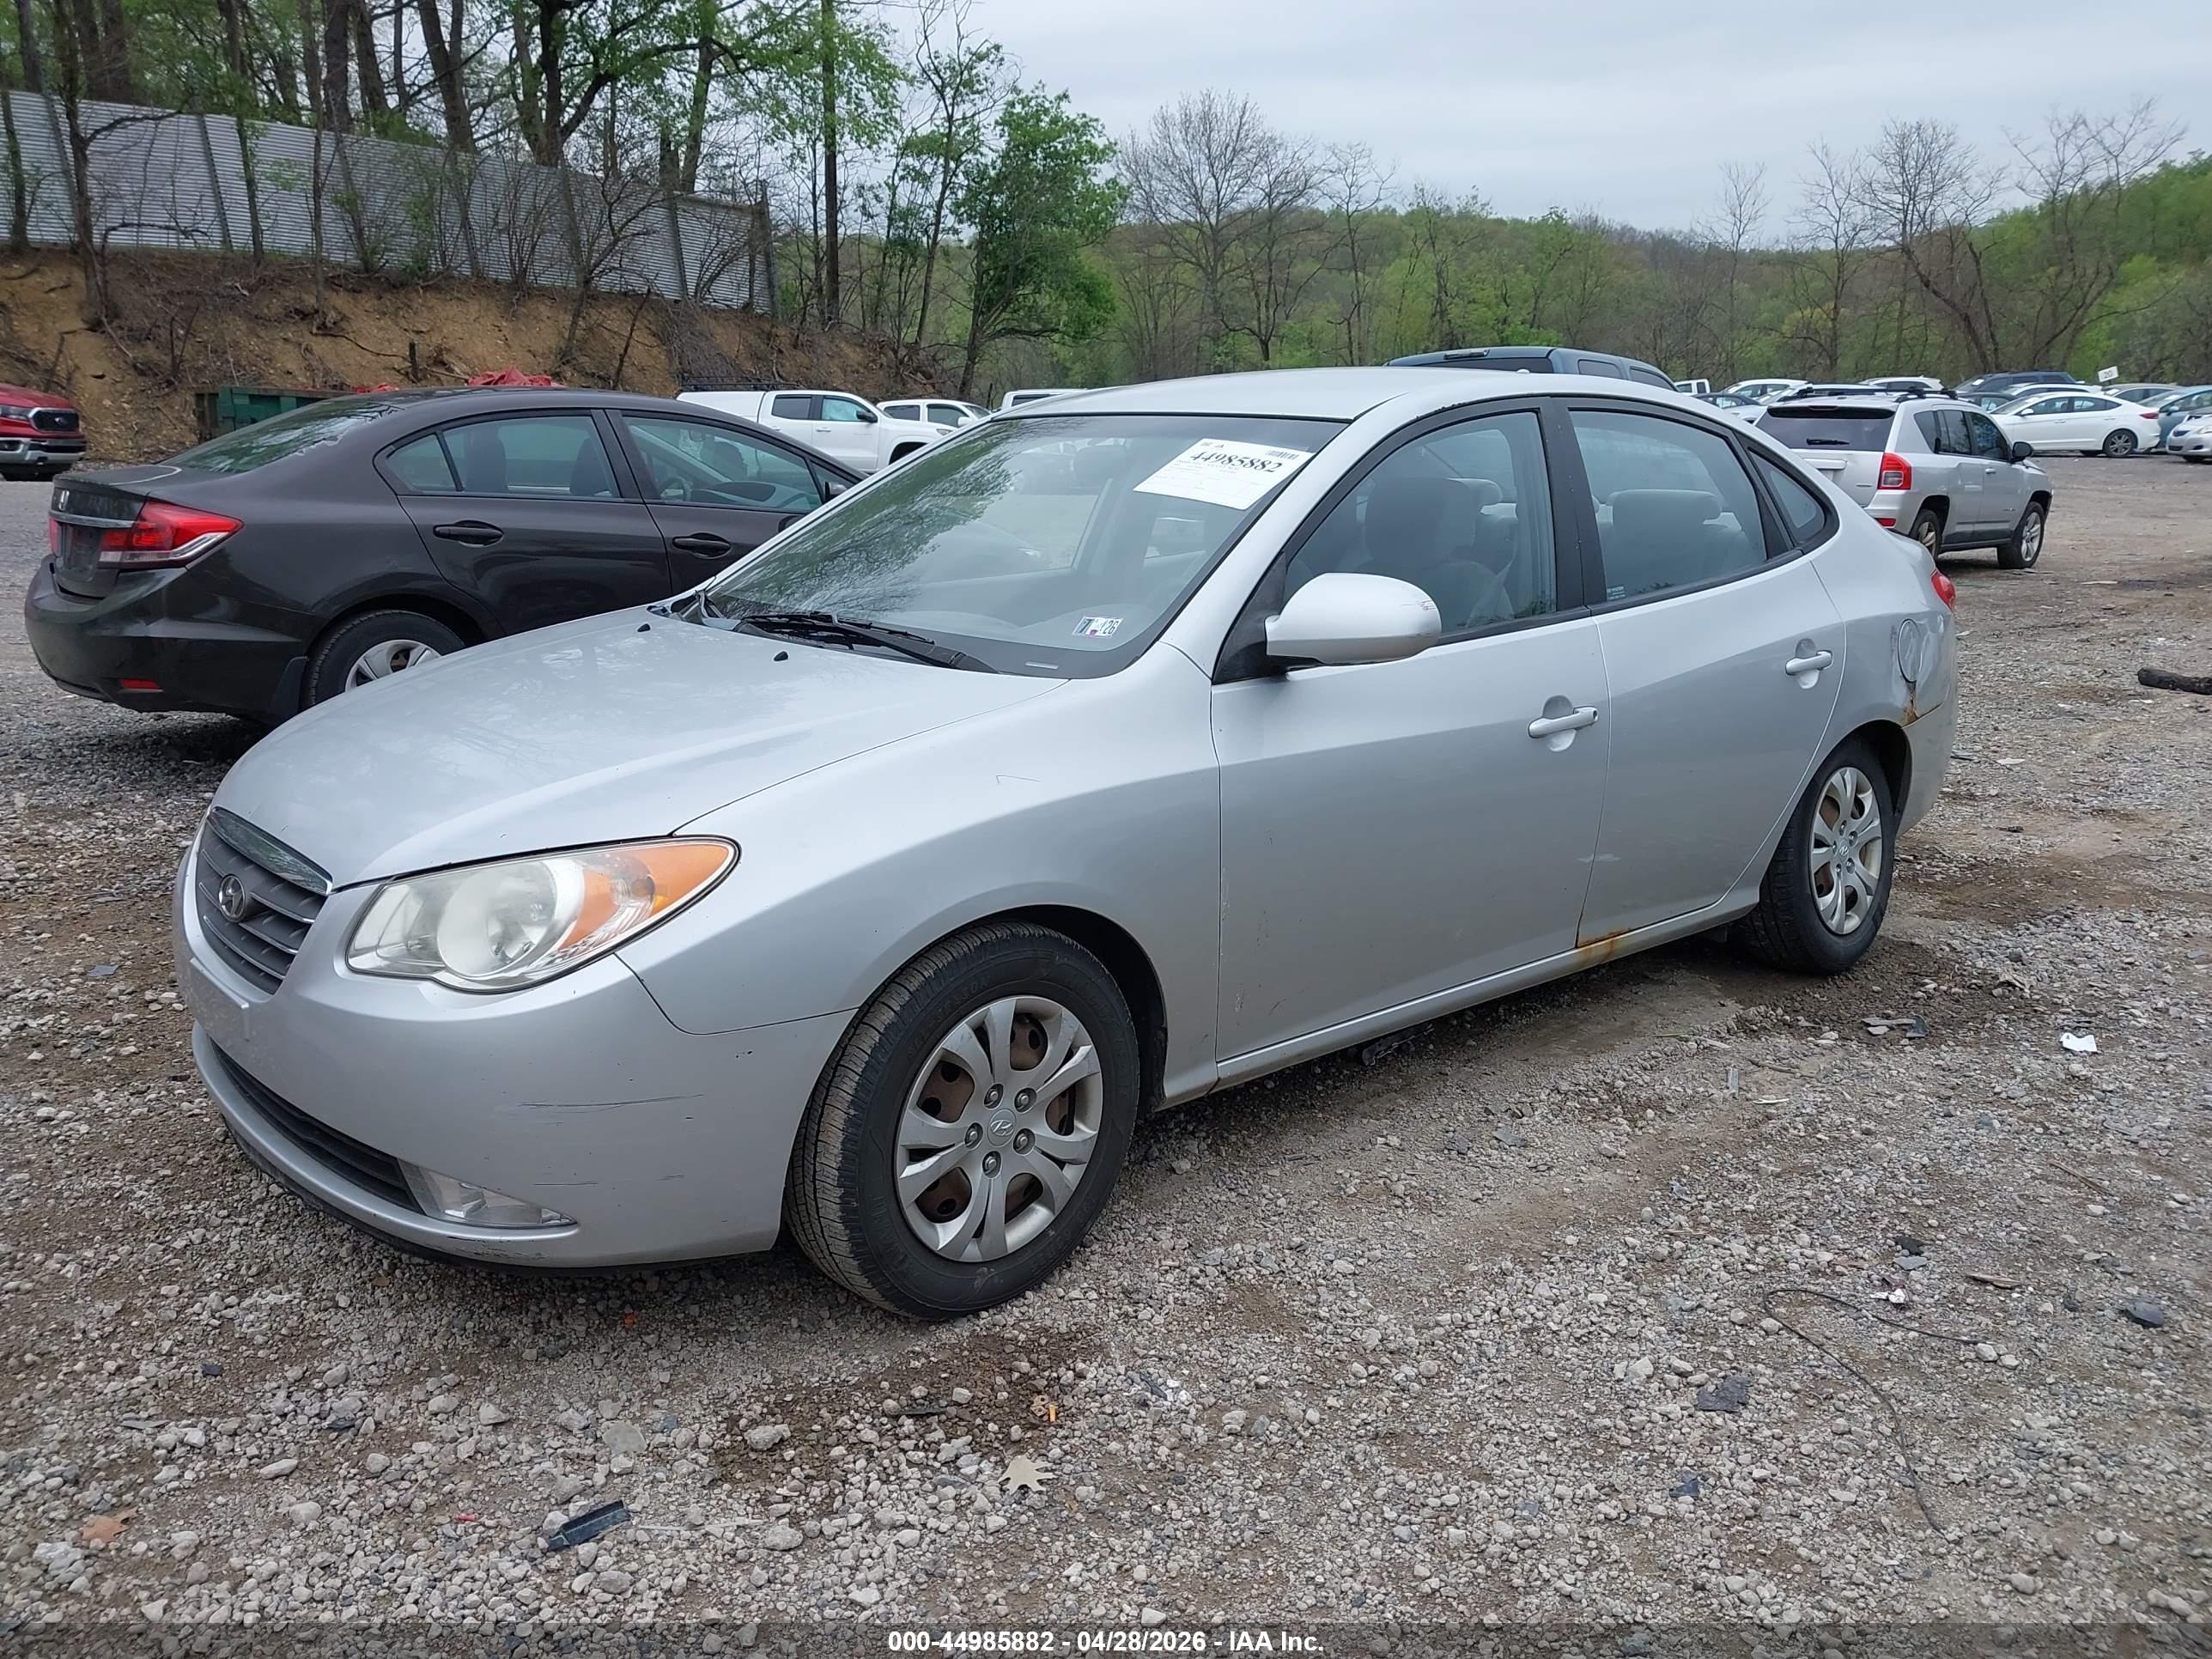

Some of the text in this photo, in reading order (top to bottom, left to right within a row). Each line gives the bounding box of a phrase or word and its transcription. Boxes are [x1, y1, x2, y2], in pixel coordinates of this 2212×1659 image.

[1190, 451, 1283, 473] 44985882
[1079, 618, 1119, 635] 7 26
